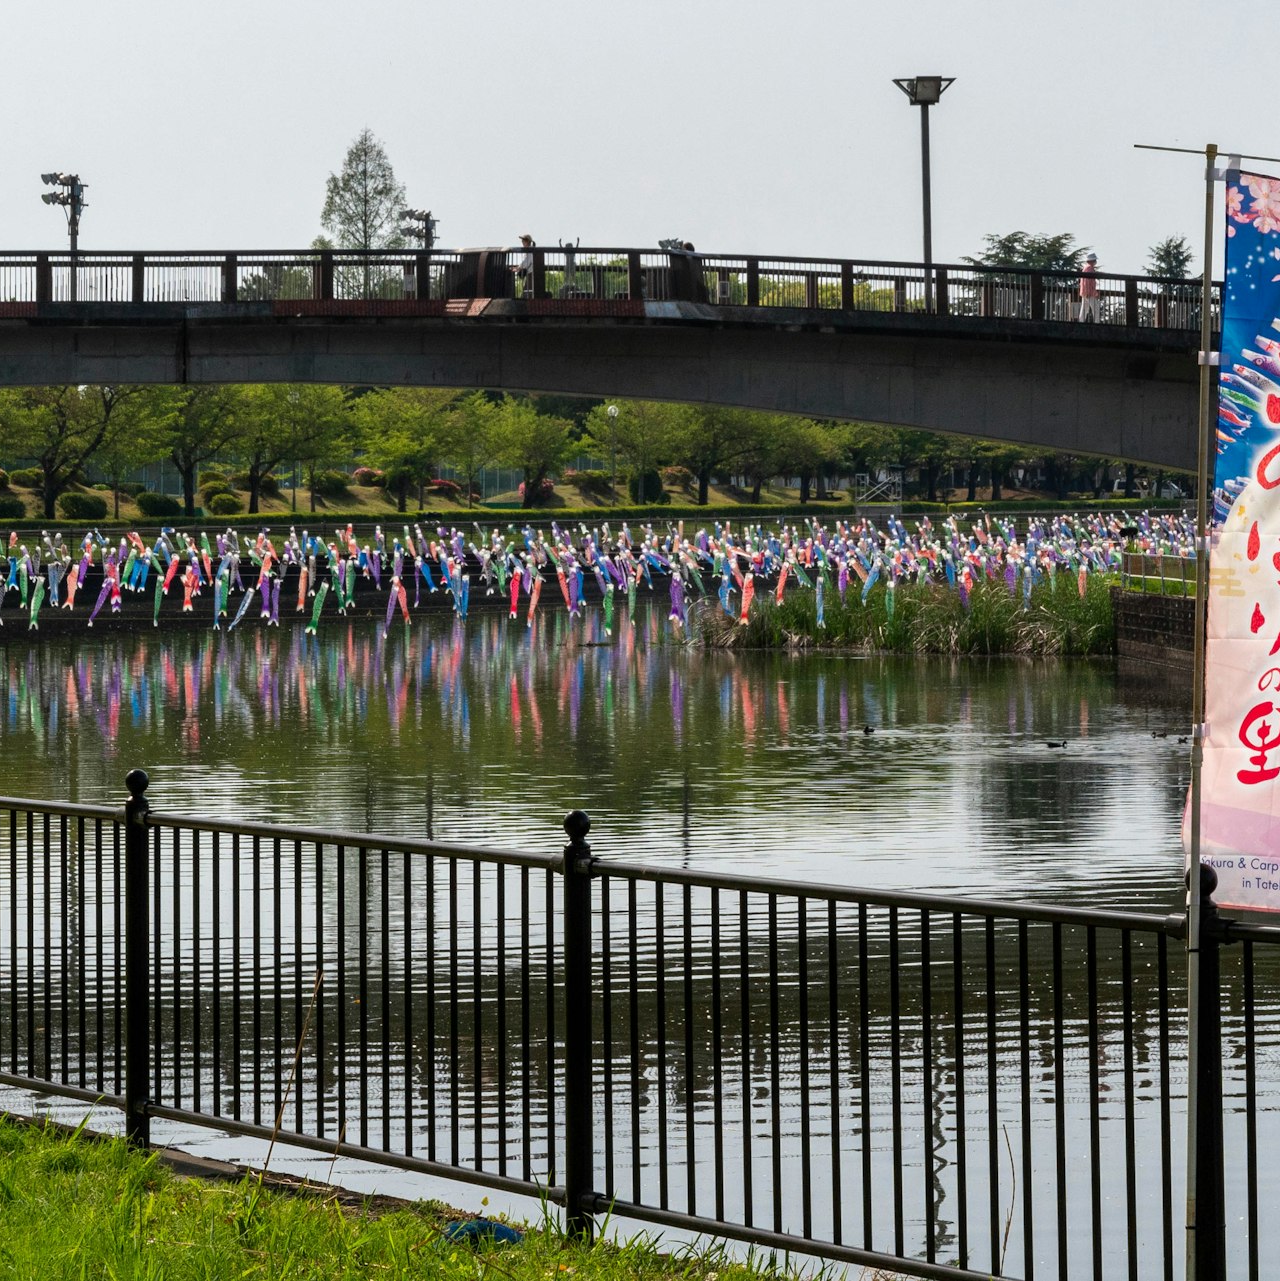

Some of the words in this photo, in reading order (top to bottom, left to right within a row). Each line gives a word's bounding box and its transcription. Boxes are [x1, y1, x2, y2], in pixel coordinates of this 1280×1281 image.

[1238, 857, 1247, 869] &
[1250, 857, 1279, 874] Carp
[1241, 877, 1252, 889] in
